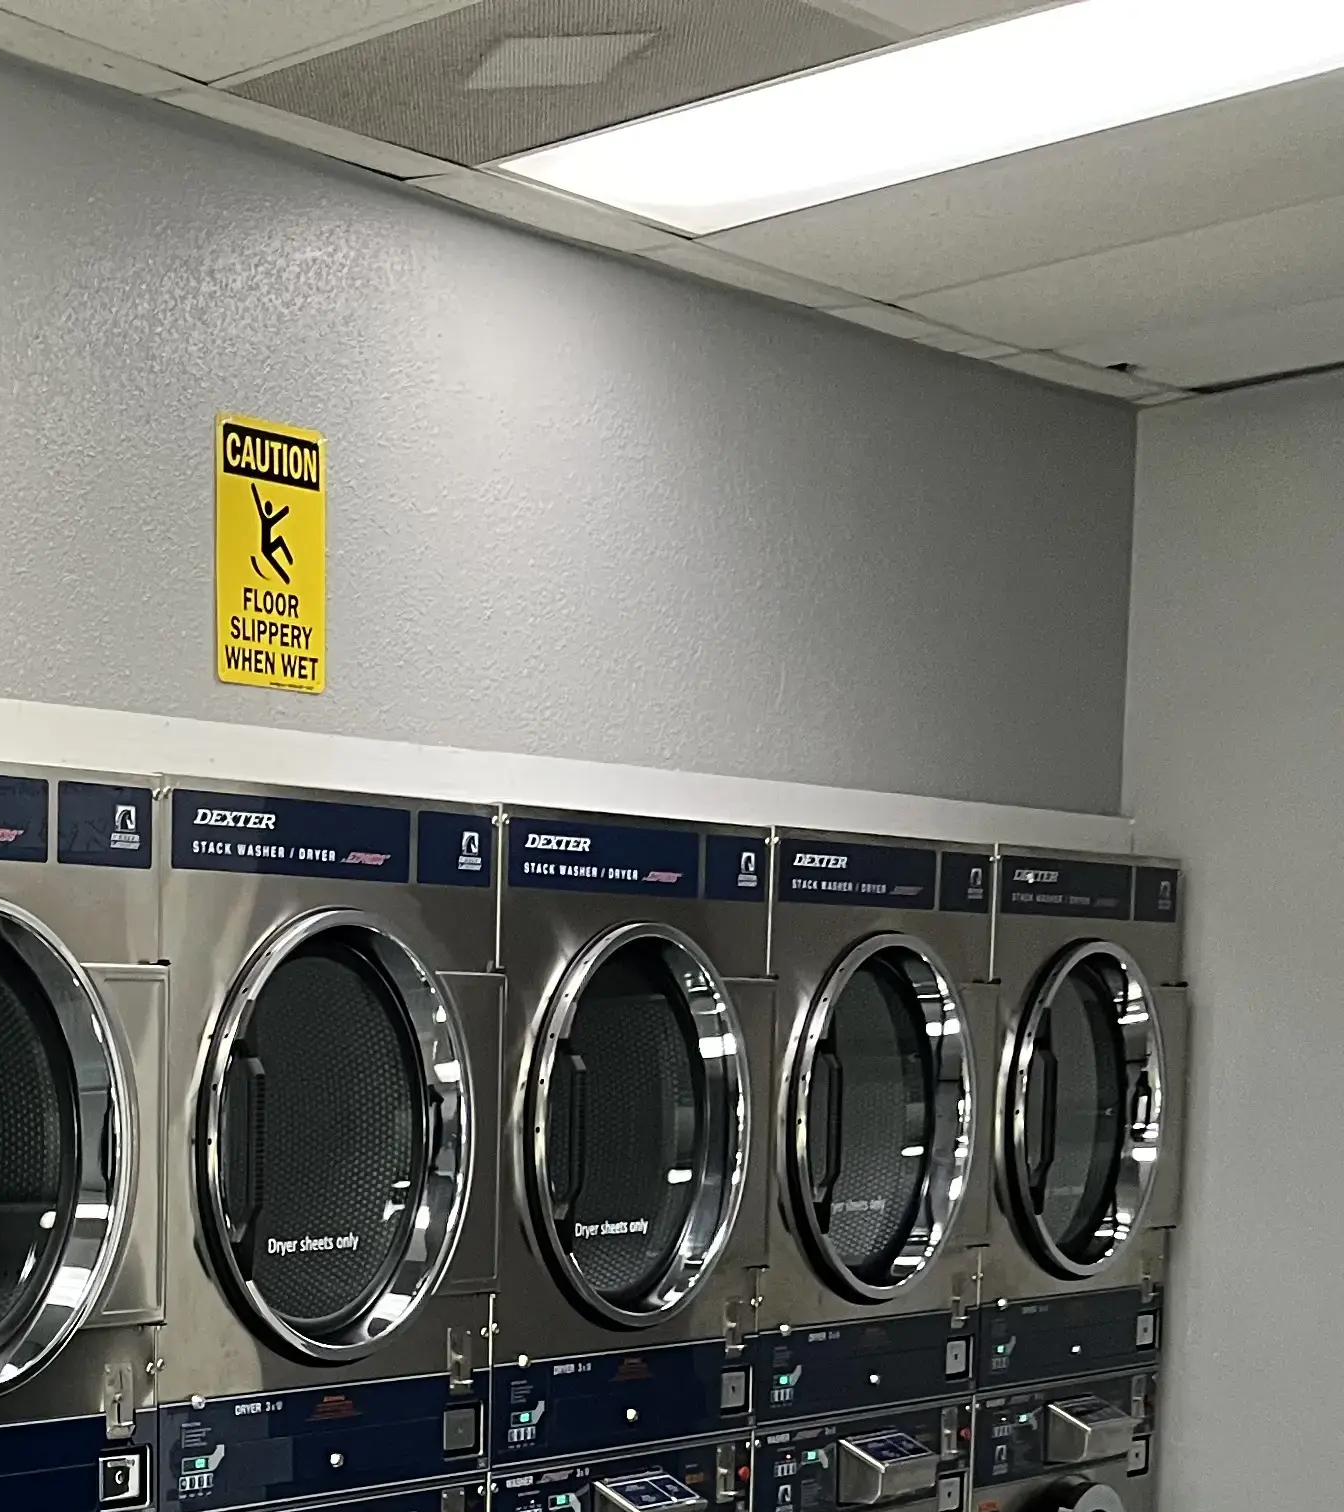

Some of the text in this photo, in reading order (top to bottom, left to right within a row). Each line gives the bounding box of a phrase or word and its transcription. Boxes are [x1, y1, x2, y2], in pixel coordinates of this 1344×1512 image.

[226, 431, 318, 484] CAUTION
[243, 586, 300, 619] FLOOR
[230, 615, 313, 650] SLIPPERY
[224, 644, 319, 681] WHEN WET
[193, 808, 276, 830] DEXTER
[192, 840, 232, 855] STACK
[237, 844, 285, 859] WASHER
[298, 848, 336, 862] DRYER
[525, 833, 591, 852] DEXTER
[793, 853, 848, 869] DEXTER
[267, 1231, 359, 1256] Dryer sheets only
